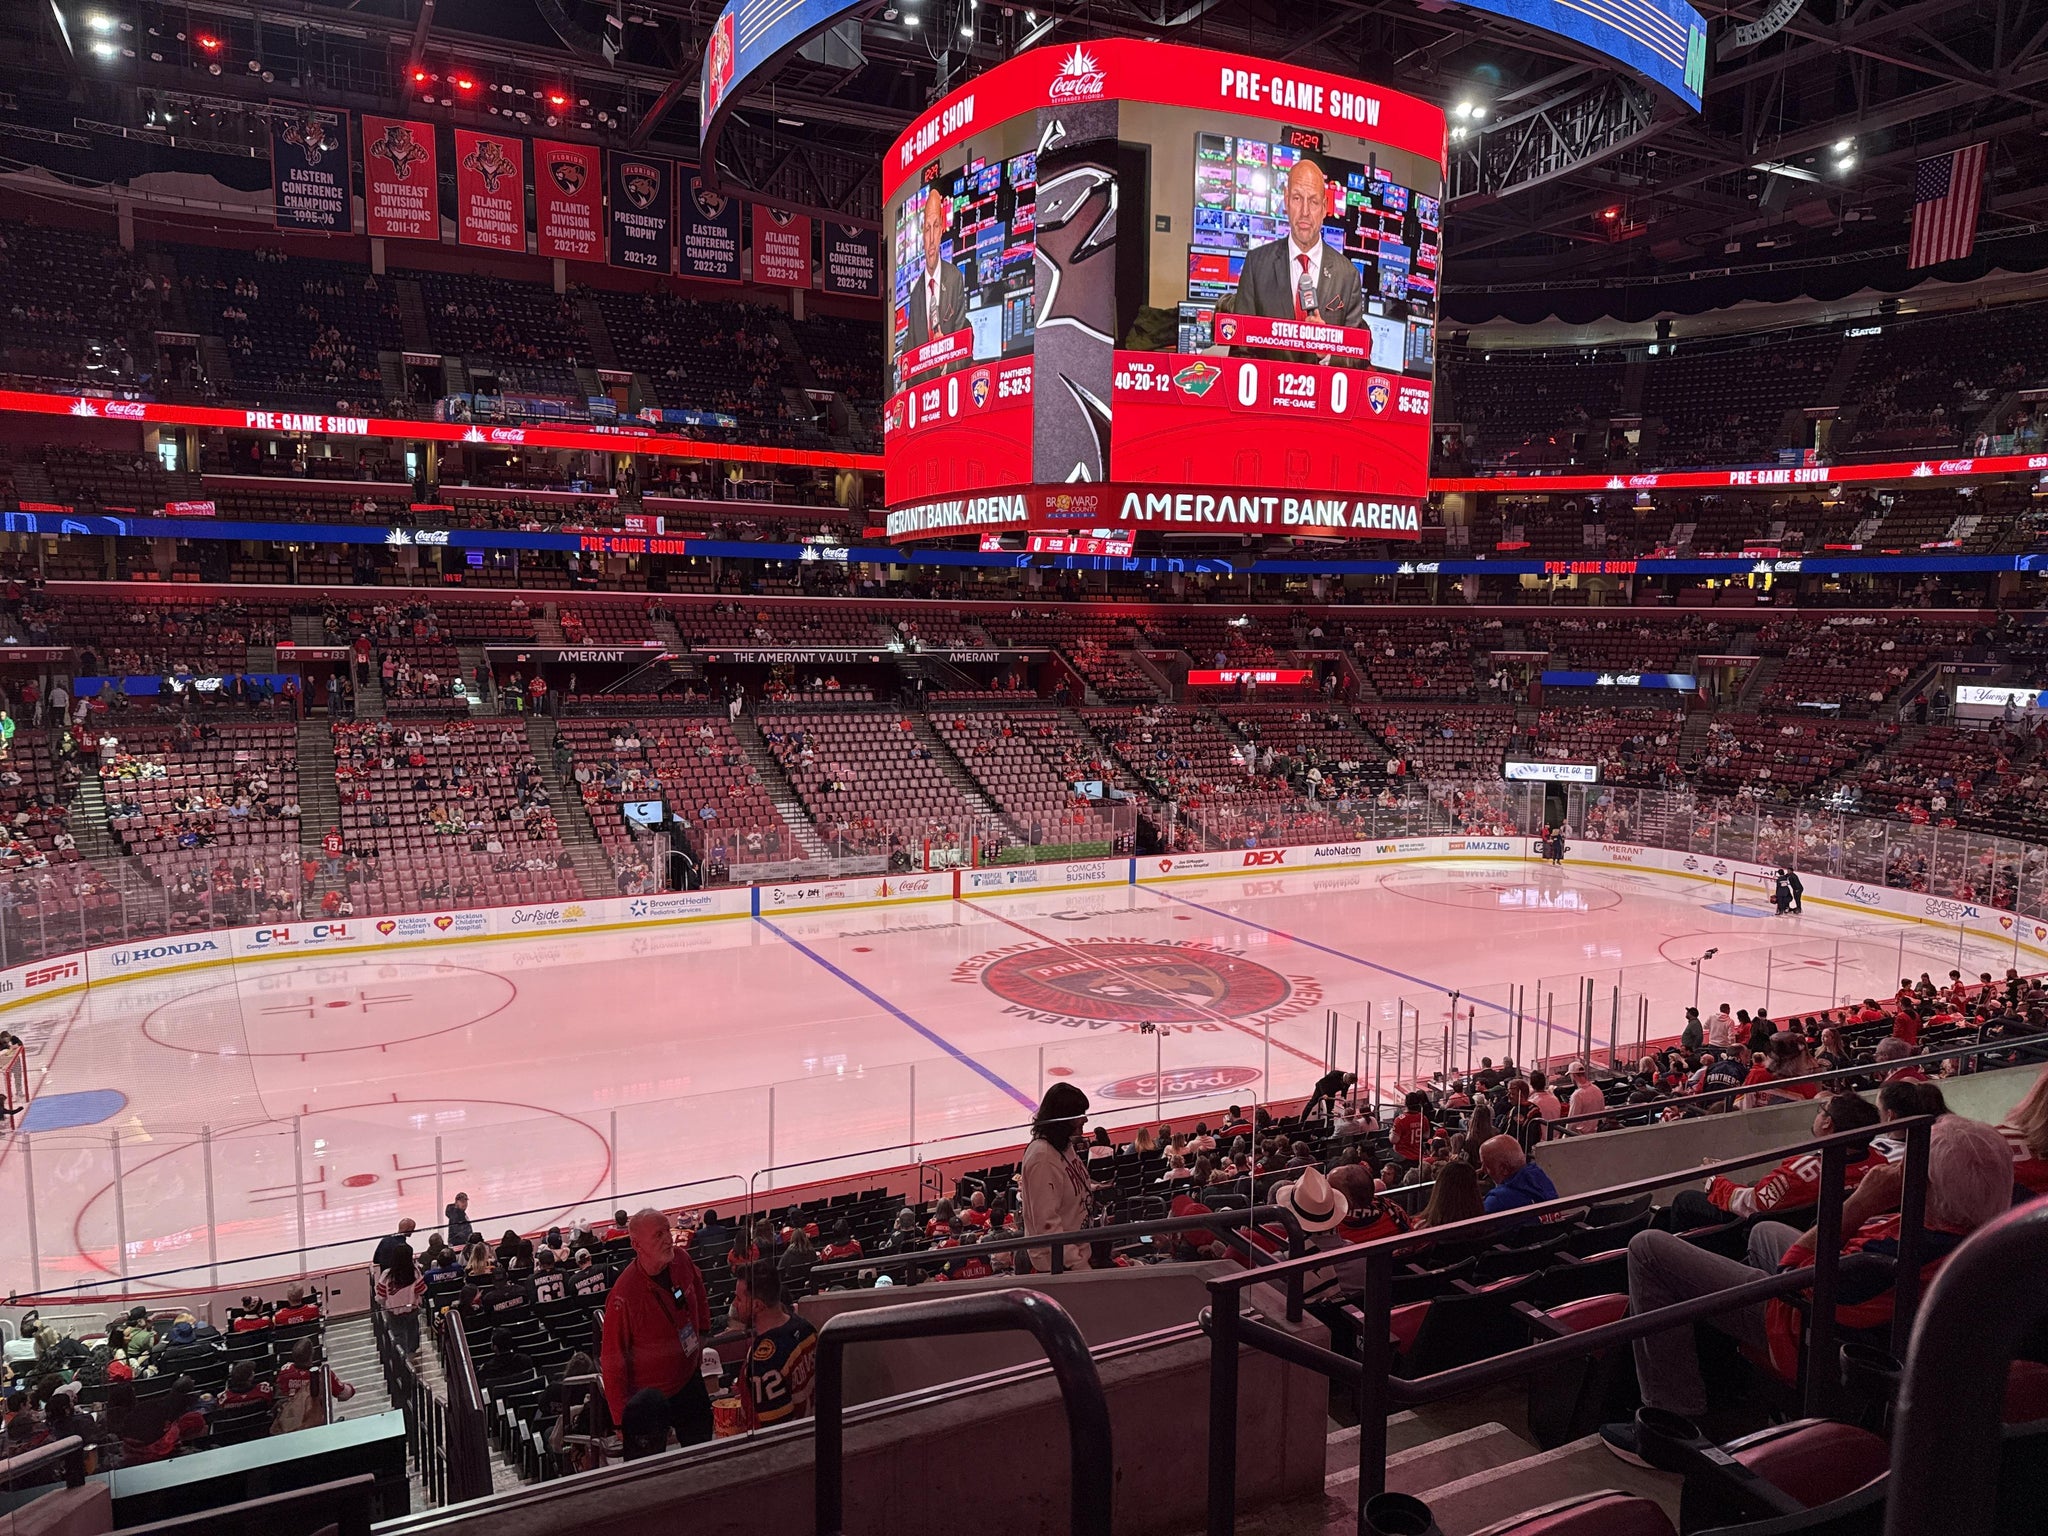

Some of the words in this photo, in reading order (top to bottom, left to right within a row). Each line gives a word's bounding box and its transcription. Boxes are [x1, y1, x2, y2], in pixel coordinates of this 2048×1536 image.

[1221, 68, 1324, 114] PRE-GAME
[1330, 89, 1380, 127] SHOW
[901, 117, 940, 170] PRE-GAME
[942, 94, 975, 137] SHOW
[1290, 131, 1319, 149] 12:29
[290, 168, 333, 184] EASTERN
[282, 181, 343, 199] CONFERENCE
[374, 182, 429, 198] SOUTHEAST
[284, 195, 342, 213] CHAMPIONS
[381, 195, 423, 209] DIVISION
[471, 194, 512, 211] ATLANTIC
[550, 201, 590, 215] ATLANTIC
[374, 207, 431, 222] CHAMPIONS
[472, 206, 511, 222] DIVISION
[552, 213, 589, 228] DIVISION
[615, 211, 666, 230] PRESIDENTS'
[386, 220, 420, 234] 2011-12
[466, 216, 518, 234] CHAMPIONS
[693, 223, 727, 238] EASTERN
[477, 231, 511, 246] 2015-16
[546, 226, 596, 242] CHAMPIONS
[625, 225, 657, 241] TROPHY
[765, 232, 800, 245] ATLANTIC
[554, 239, 589, 254] 2021-22
[685, 235, 735, 250] CONFERENCE
[766, 243, 799, 257] DIVISION
[836, 241, 868, 256] EASTERN
[624, 251, 657, 266] 2021-22
[686, 247, 734, 262] CHAMPIONS
[760, 254, 805, 270] CHAMPIONS
[829, 253, 874, 268] CONFERENCE
[694, 260, 727, 274] 2022-23
[767, 267, 798, 281] 2023-24
[830, 264, 873, 279] CHAMPIONS
[837, 277, 867, 290] 2023-24
[1271, 321, 1298, 338] STEVE
[1299, 326, 1343, 343] GOLDSTEIN
[1246, 335, 1305, 349] BROADCASTER,
[1306, 341, 1336, 352] SCRIPPS
[1336, 345, 1363, 355] SPORTS
[1000, 367, 1031, 380] PANTHERS
[1128, 362, 1154, 372] WILD
[998, 376, 1031, 398] 35-32-3
[1115, 372, 1169, 391] 40-20-12
[1238, 363, 1258, 407] 0
[1277, 373, 1315, 396] 12:29
[948, 377, 958, 418] 0
[1331, 372, 1348, 414] 0
[1400, 387, 1430, 399] PANTHERS
[908, 391, 916, 429] 0
[1273, 398, 1316, 409] PRE-GAME
[1398, 397, 1429, 415] 35-32-3
[246, 411, 322, 432] PRE-GAME
[327, 416, 369, 435] SHOW
[1729, 470, 1790, 485] PRE-GAME
[1793, 467, 1829, 482] SHOW
[926, 500, 966, 528] BANK
[966, 494, 1027, 526] ARENA
[1071, 505, 1097, 513] COUNTY
[1120, 492, 1279, 524] AMERANT
[1283, 498, 1348, 527] BANK
[1351, 501, 1419, 531] ARENA
[580, 536, 646, 553] PRE-GAME
[650, 540, 685, 555] SHOW
[1544, 561, 1600, 574] PRE-GAME
[1602, 561, 1637, 573] SHOW
[45, 651, 64, 661] 132
[280, 651, 297, 660] 132
[330, 651, 345, 660] 133
[558, 651, 624, 662] AMERANT
[734, 652, 754, 662] THE
[757, 652, 815, 663] AMERANT
[818, 652, 858, 663] VAULT
[949, 652, 1000, 662] AMERANT
[1256, 672, 1277, 682] SHOW
[1560, 766, 1570, 774] FIT.
[328, 841, 338, 851] 13
[1314, 846, 1361, 857] AutoNation
[1376, 845, 1396, 853] WM
[1466, 842, 1510, 850] AMAZING
[1602, 845, 1644, 855] AMERANT
[1243, 850, 1287, 866] DEX
[1613, 854, 1632, 862] BANK
[1066, 863, 1106, 873] COMCAST
[1066, 871, 1106, 881] BUSINESS
[899, 879, 929, 892] Coca-Cola
[650, 898, 686, 908] Broward
[686, 896, 712, 905] Health
[1925, 897, 1963, 912] OMEGA
[511, 908, 559, 925] Surfside
[650, 907, 676, 916] Pediatric
[1925, 907, 1961, 920] SPORT
[1961, 905, 1980, 918] XL
[398, 916, 427, 925] Nicklaus
[398, 923, 431, 931] Children's
[455, 918, 487, 926] Children's
[455, 923, 482, 931] Hospital
[398, 928, 426, 936] Hospital
[133, 940, 218, 961] HONDA
[1066, 936, 1149, 945] BANK
[1154, 938, 1248, 957] ARENA
[1038, 953, 1173, 978] PANTHERS
[25, 961, 78, 988] ESPN
[1136, 1072, 1232, 1096] Ford
[534, 1273, 564, 1285] MARCHAND
[574, 1273, 605, 1290] MARCHAND
[493, 1296, 524, 1312] MARCHAND
[752, 1370, 786, 1404] 12
